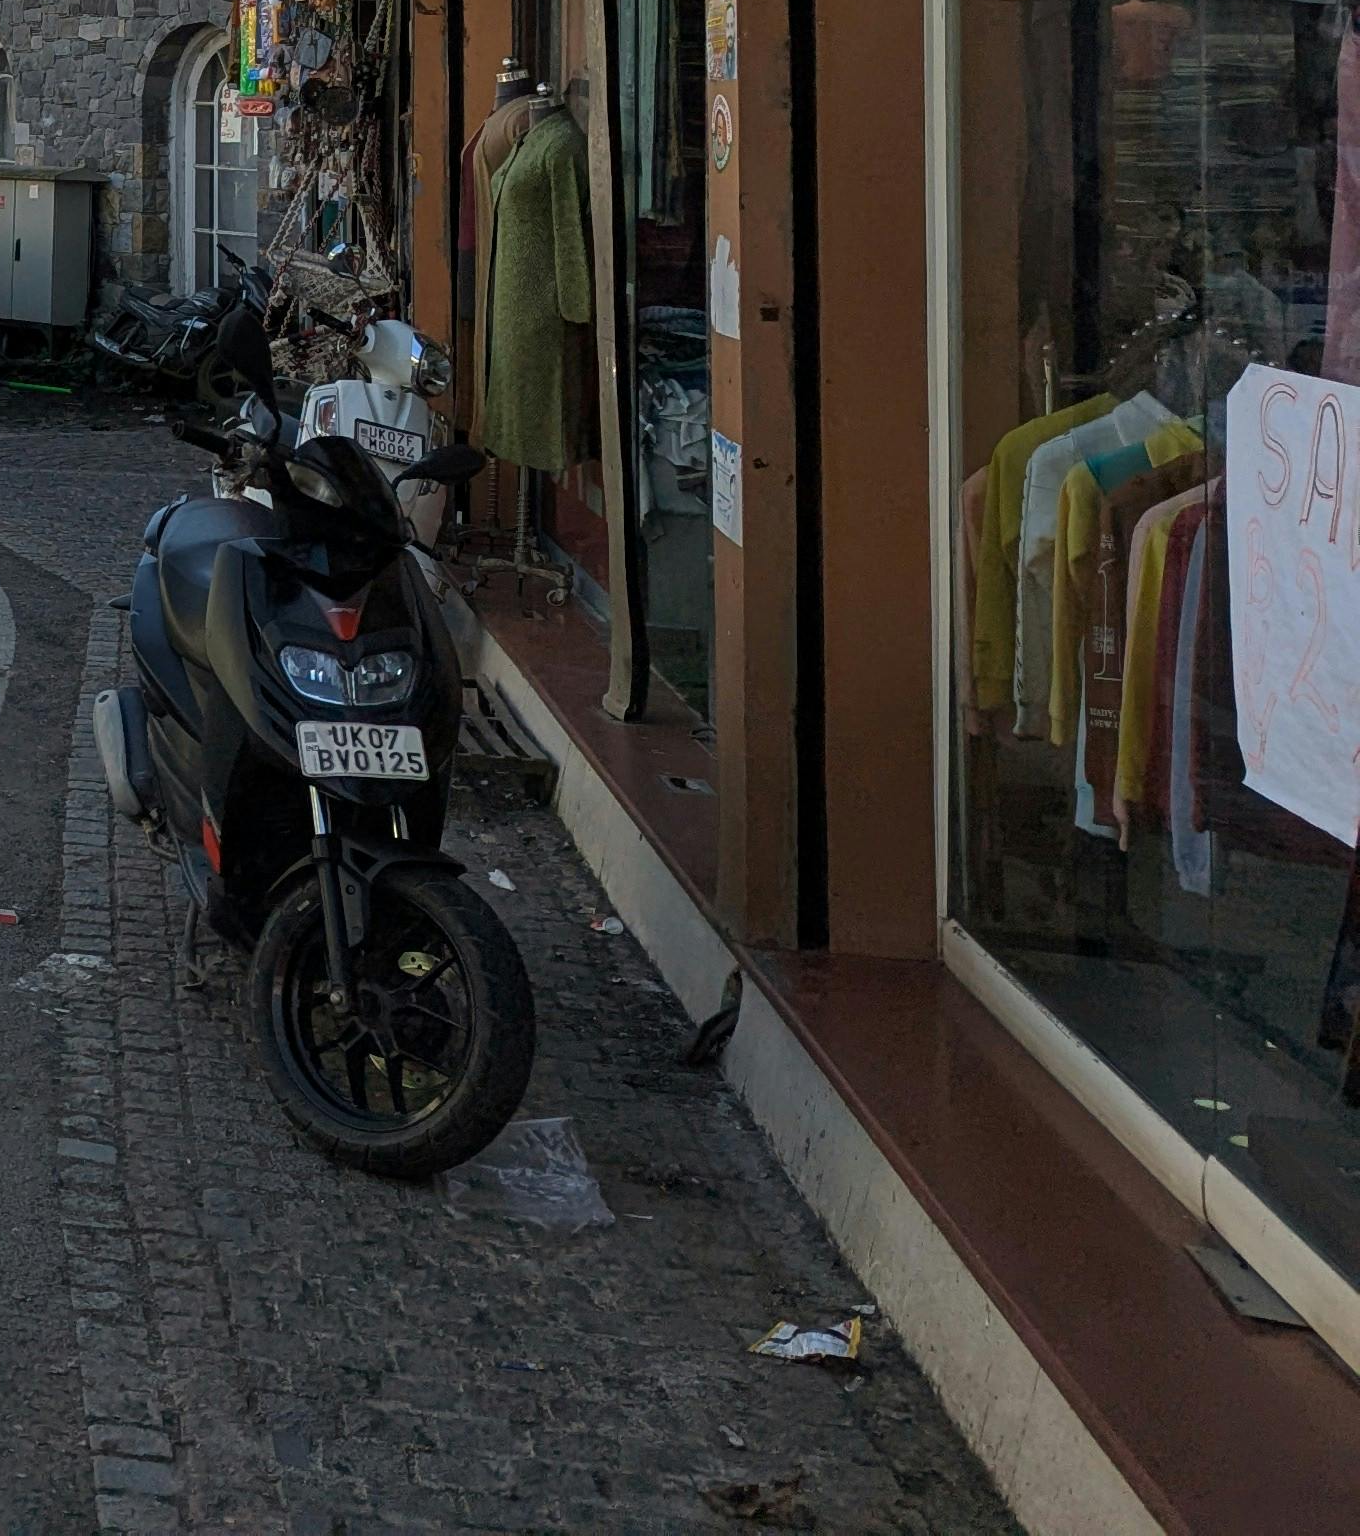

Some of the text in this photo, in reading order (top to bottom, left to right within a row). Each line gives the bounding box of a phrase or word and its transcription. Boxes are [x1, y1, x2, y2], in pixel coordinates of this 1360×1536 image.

[1258, 382, 1360, 572] SA
[332, 725, 399, 750] UK07
[318, 748, 424, 774] BV0125
